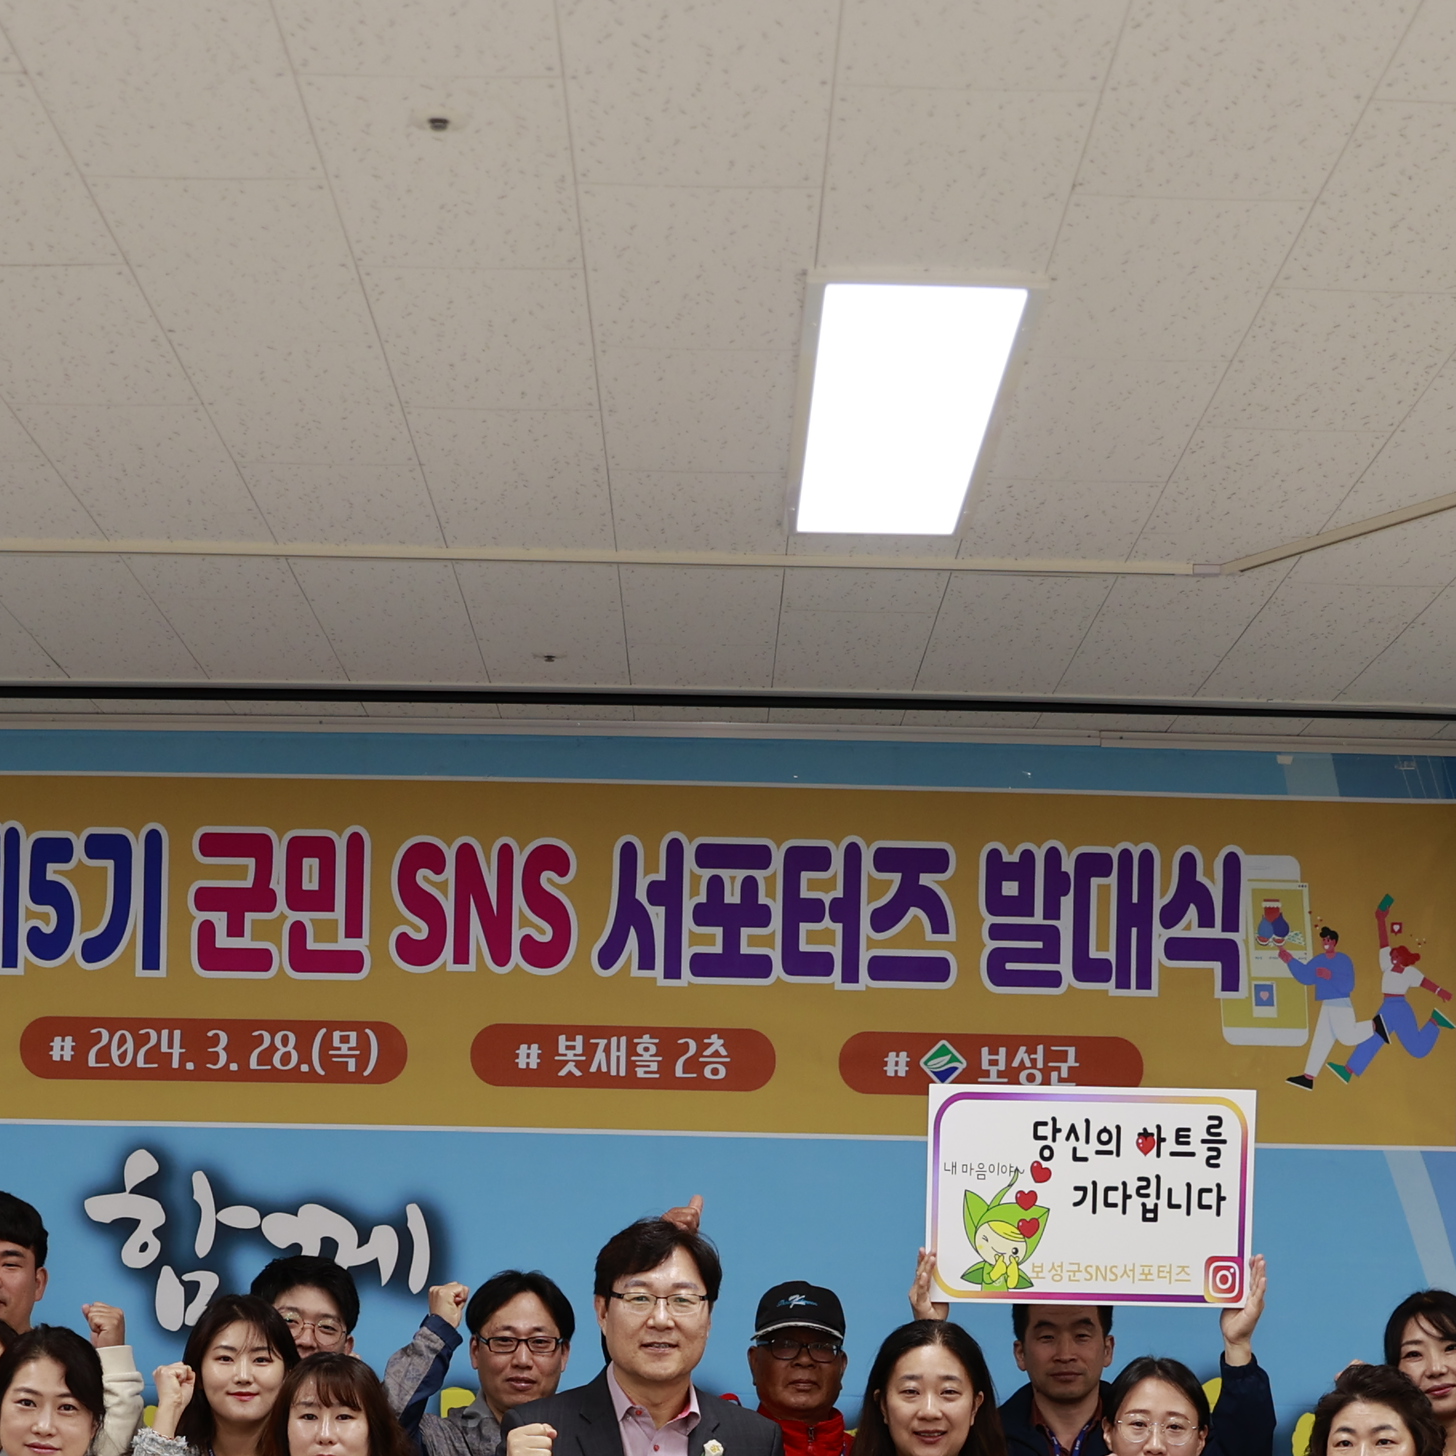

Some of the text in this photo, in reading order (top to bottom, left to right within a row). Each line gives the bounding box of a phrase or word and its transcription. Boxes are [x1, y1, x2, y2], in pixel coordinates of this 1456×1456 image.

[192, 827, 371, 980] 군민
[391, 835, 577, 974] SNS
[591, 832, 957, 988] 서포터즈
[980, 842, 1248, 998] 발대식
[554, 1034, 663, 1078] 봇재홀
[675, 1033, 731, 1080] 2층
[978, 1044, 1079, 1086] 보성군
[1032, 1115, 1228, 1168] 당신의 하트를
[944, 1161, 957, 1175] 내
[1072, 1173, 1227, 1222] 기다립니다
[84, 1148, 432, 1332] 함께
[1029, 1261, 1192, 1285] 보성군SNS서포터즈
